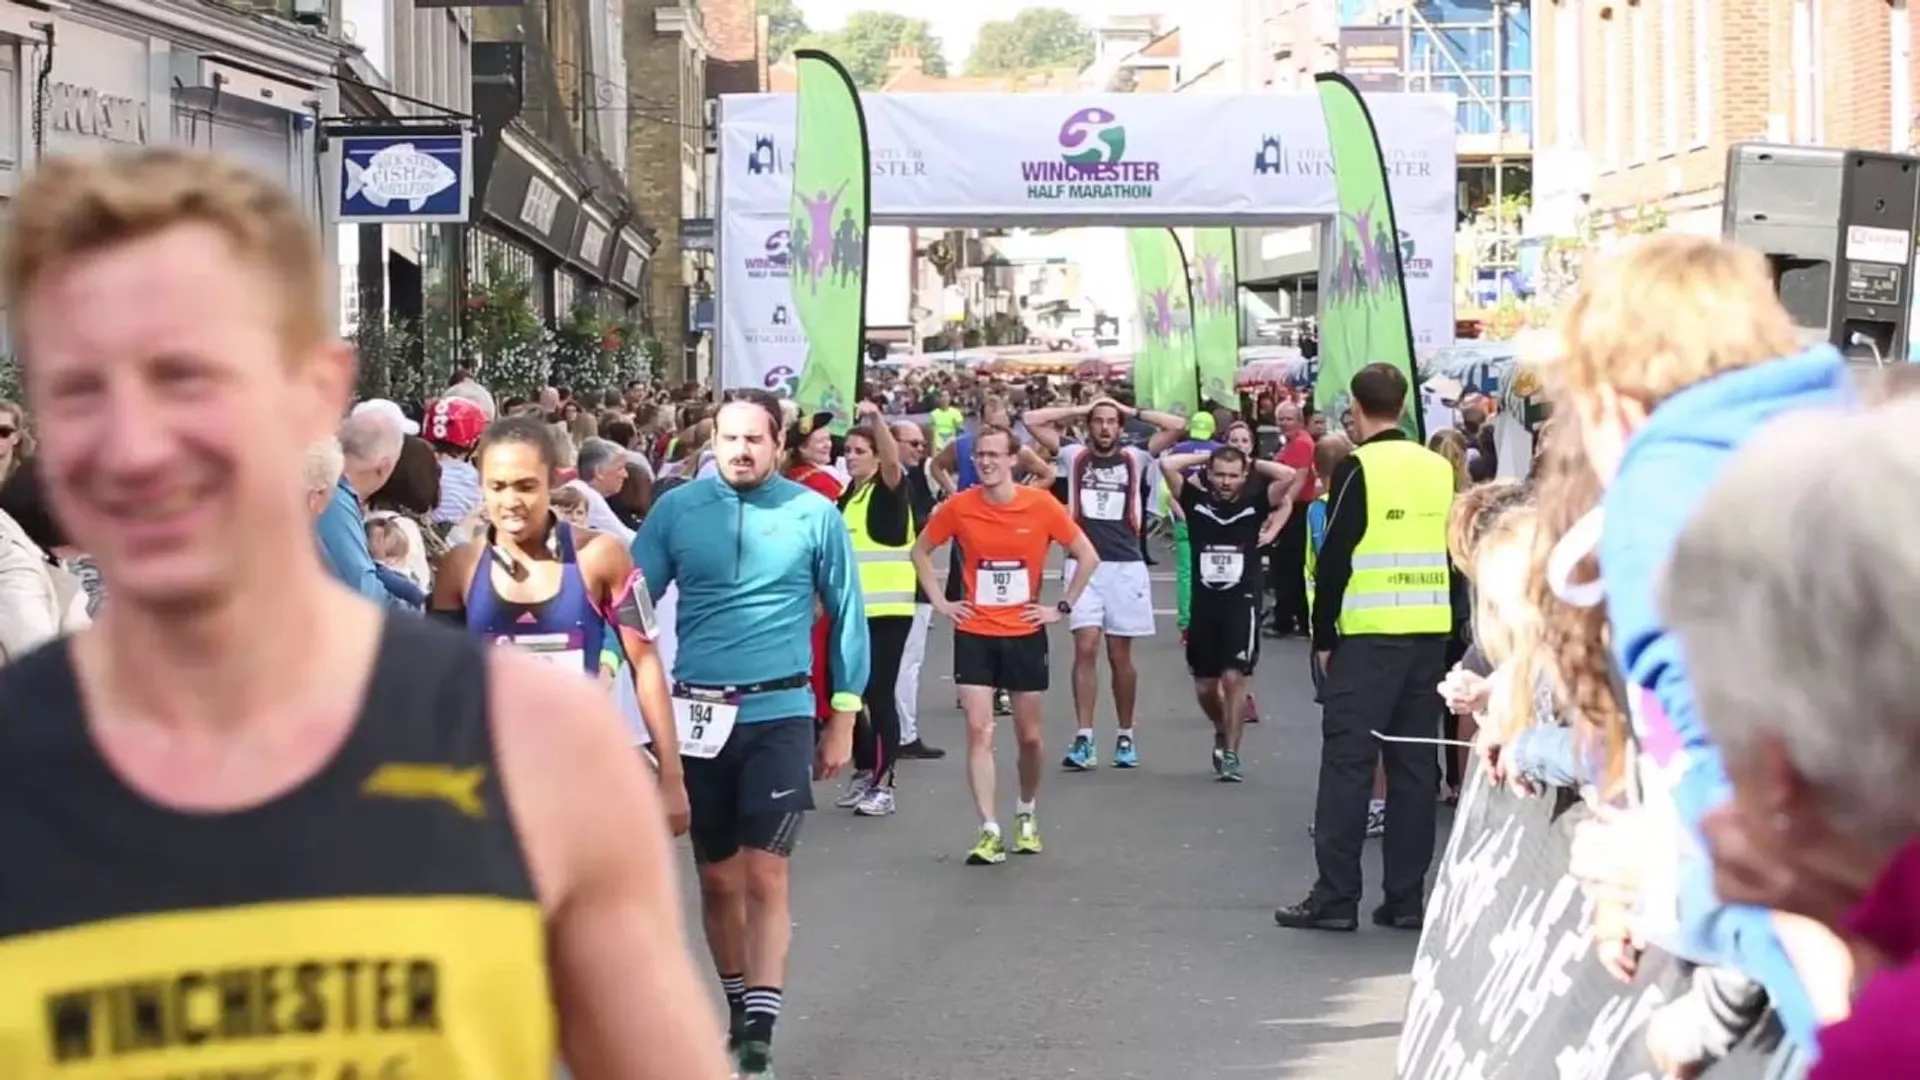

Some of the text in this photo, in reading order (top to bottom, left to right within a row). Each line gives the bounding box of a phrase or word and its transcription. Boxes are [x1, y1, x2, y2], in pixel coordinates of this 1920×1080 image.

[1021, 161, 1160, 181] WINCHESTER
[1027, 184, 1153, 199] HALF MARATHON
[992, 572, 1012, 585] 107
[689, 704, 713, 724] 194
[47, 959, 439, 1062] WINCHESTER
